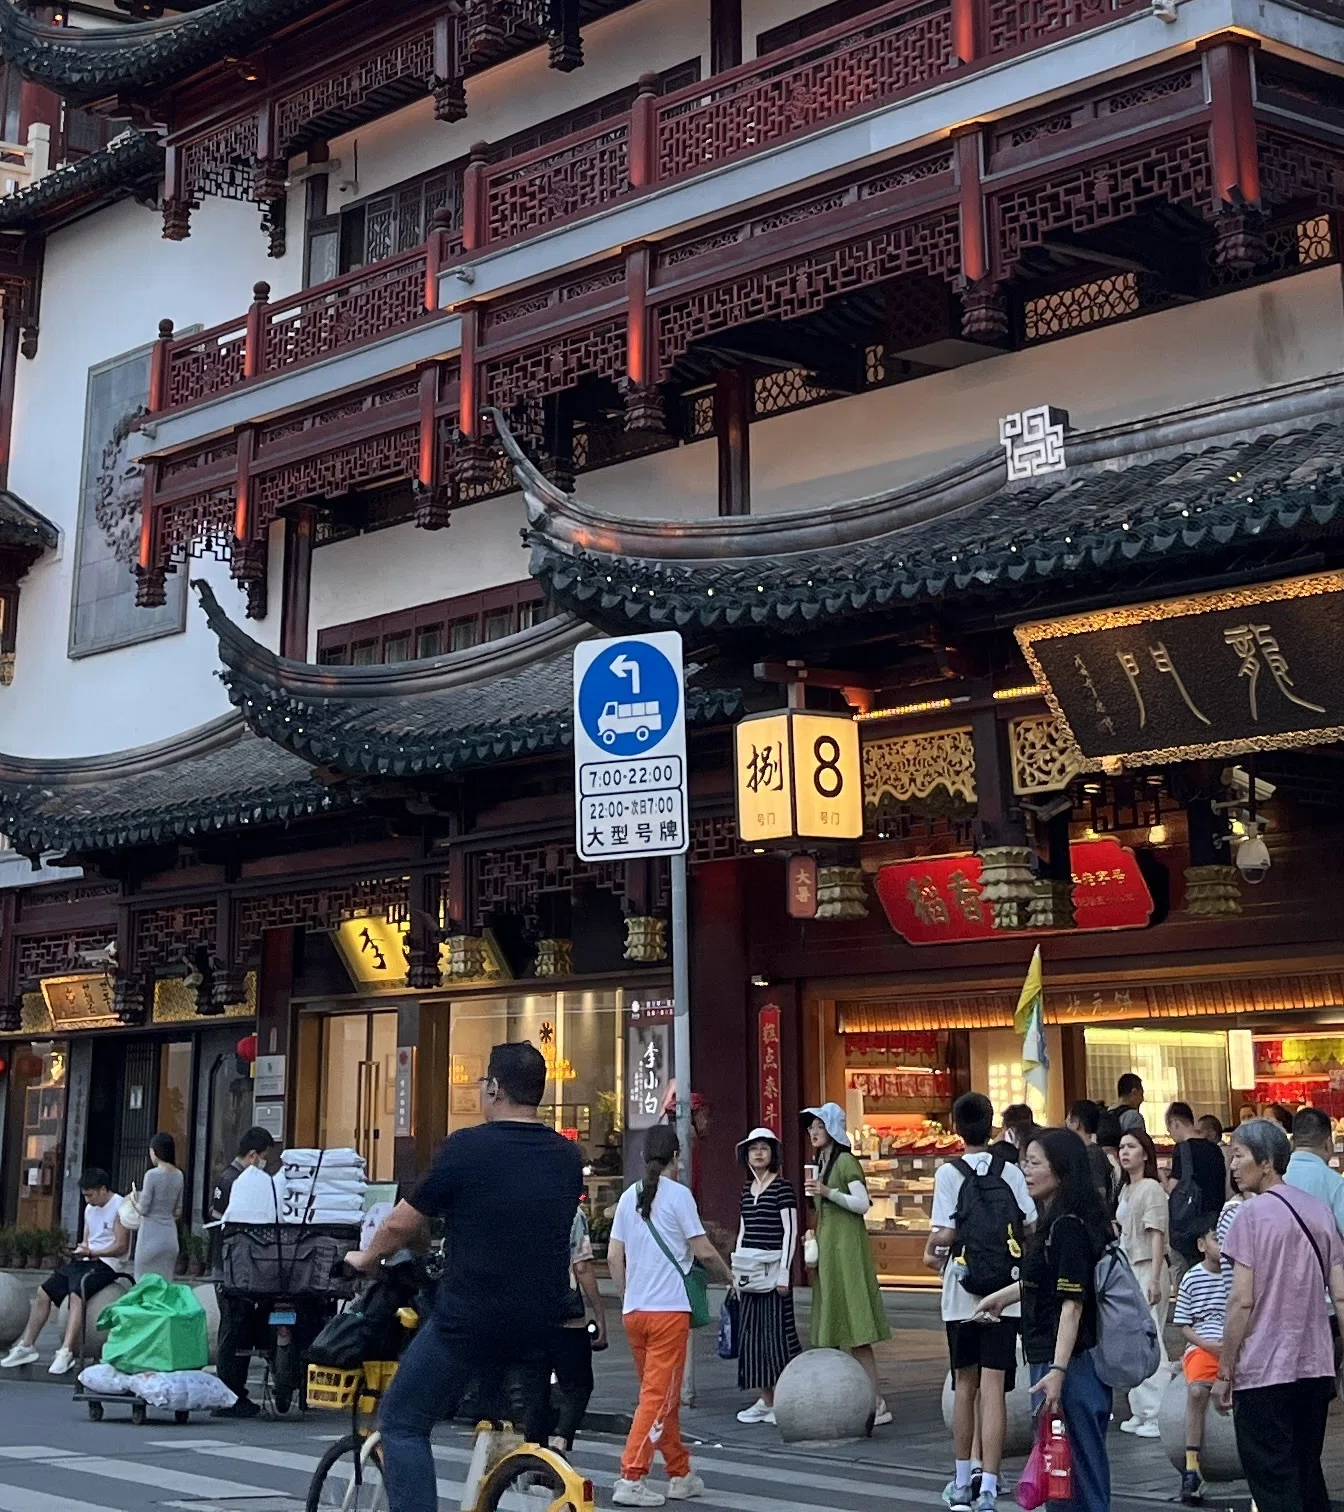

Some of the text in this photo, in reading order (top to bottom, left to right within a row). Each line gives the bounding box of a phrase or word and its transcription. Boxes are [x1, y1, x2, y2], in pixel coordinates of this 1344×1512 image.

[745, 740, 784, 794] 捌
[813, 735, 844, 798] 8
[586, 821, 679, 848] 大型号牌
[757, 812, 776, 826] 号门
[820, 811, 840, 826] 号门
[643, 1041, 659, 1114] 李小白
